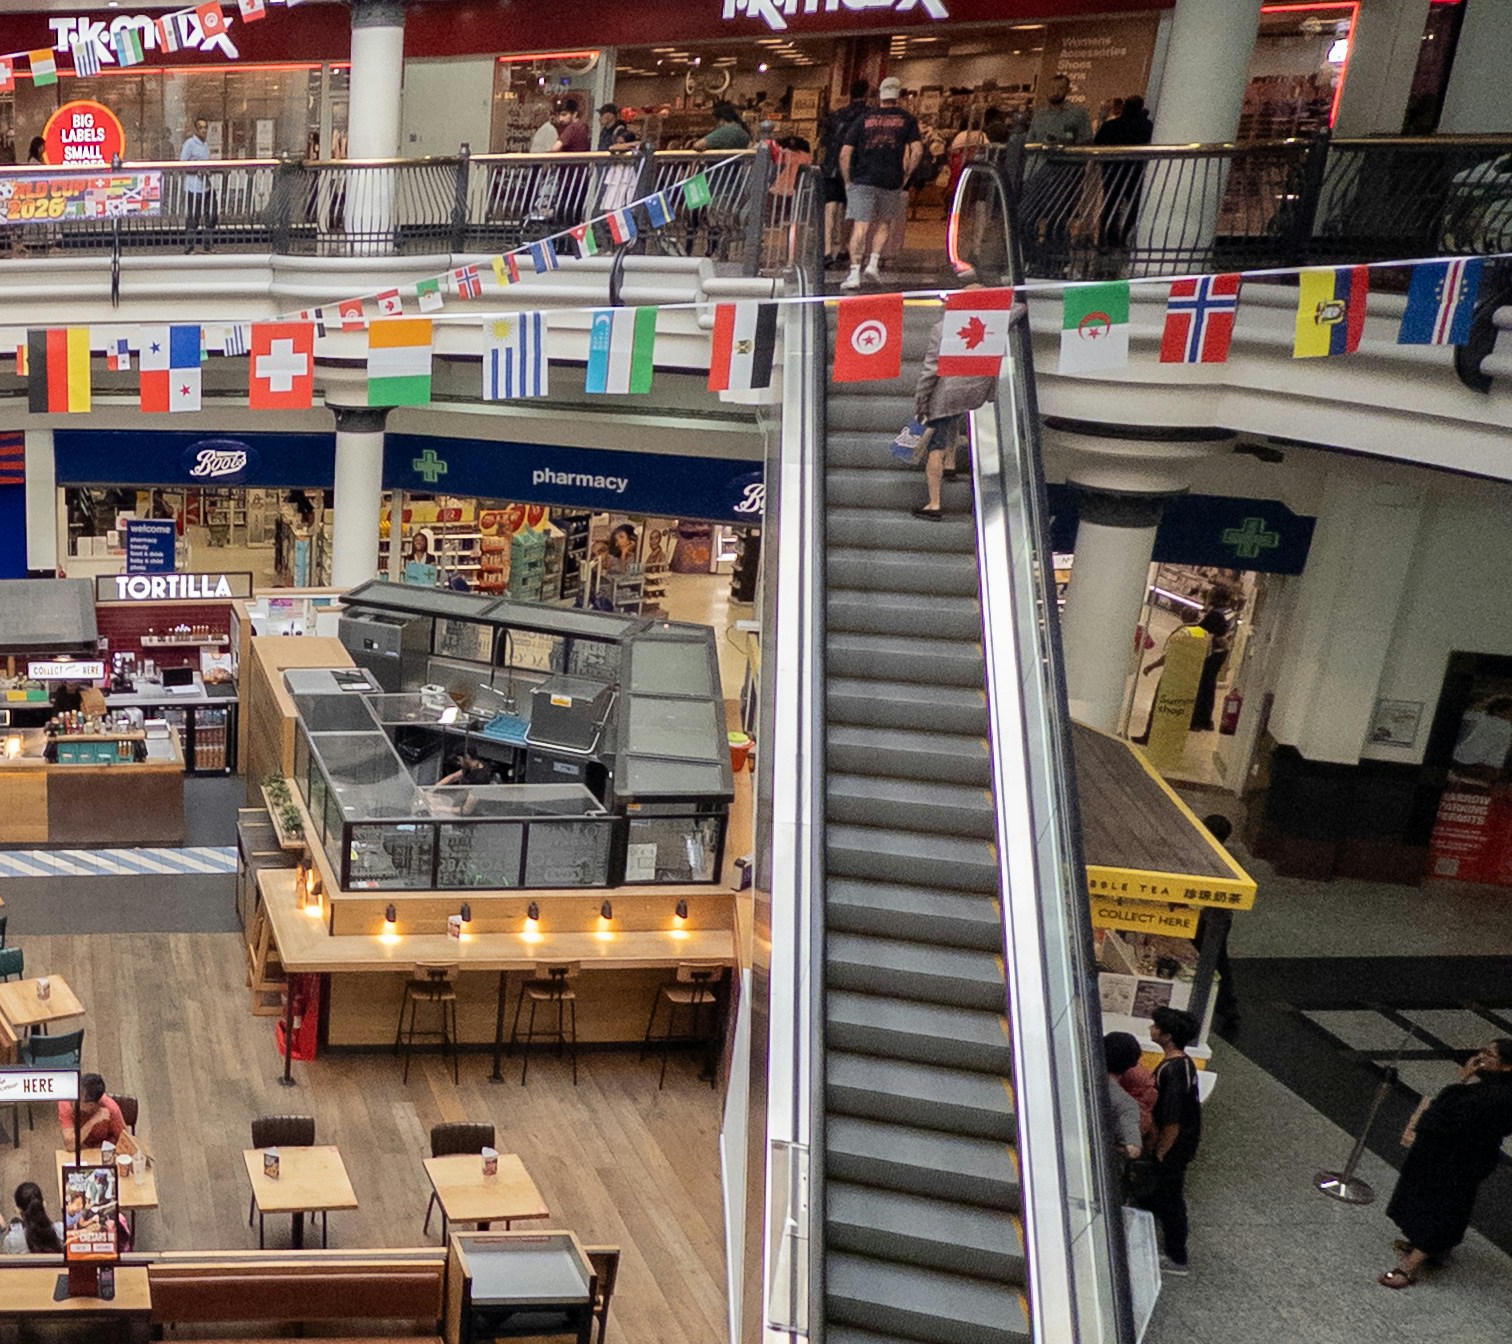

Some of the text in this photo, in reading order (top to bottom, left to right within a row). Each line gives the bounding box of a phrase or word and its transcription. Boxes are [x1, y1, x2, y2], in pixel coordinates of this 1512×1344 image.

[72, 113, 94, 127] BIG
[61, 128, 105, 143] LABELS
[64, 146, 102, 159] SMALL
[50, 179, 87, 198] CUP
[7, 197, 66, 221] 2026
[189, 449, 247, 477] Boots
[532, 467, 629, 493] pharmacy
[130, 524, 171, 533] welcome
[116, 575, 232, 599] TORTILLA
[33, 665, 63, 676] COLLECT
[83, 664, 100, 675] HERE
[1140, 884, 1170, 895] TEA
[1098, 908, 1191, 929] COLLECT HERE
[23, 1078, 54, 1093] HERE
